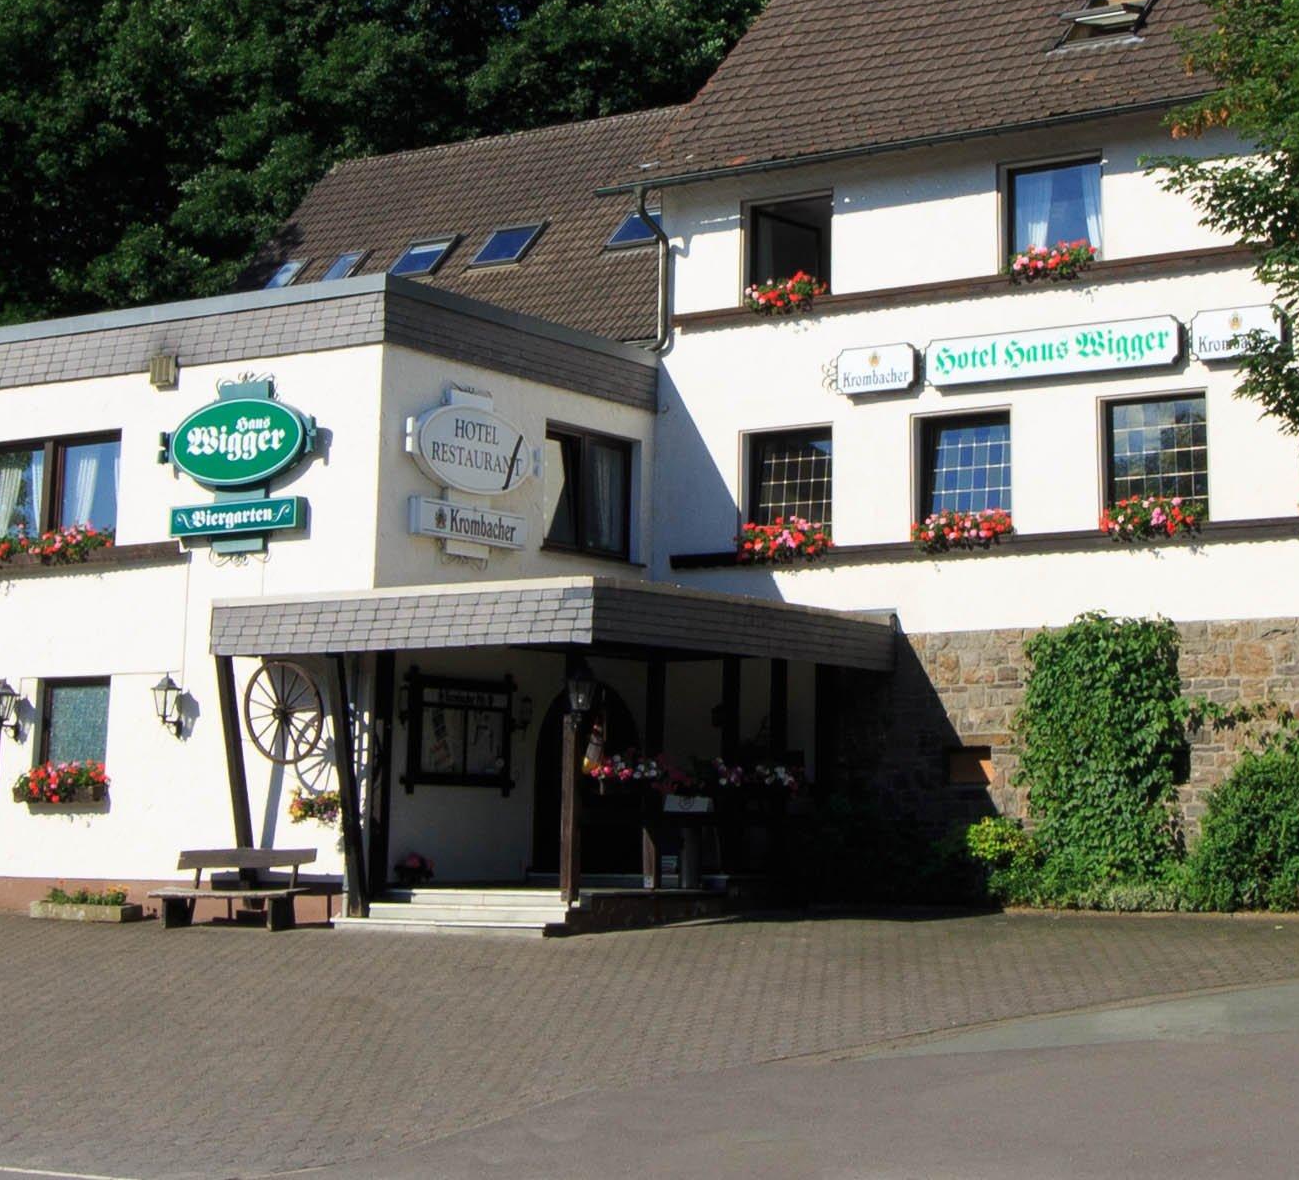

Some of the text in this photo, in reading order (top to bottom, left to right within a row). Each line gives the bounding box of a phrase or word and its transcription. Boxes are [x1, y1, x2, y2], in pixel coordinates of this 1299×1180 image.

[935, 329, 1170, 375] Hotel Haus Wigger
[843, 367, 910, 388] Krombacher
[235, 416, 271, 432] Haus
[454, 418, 499, 445] HOTEL
[186, 424, 286, 461] Wigger
[431, 440, 523, 477] RESTAURANT
[191, 507, 273, 529] Biergarten
[450, 507, 517, 542] Krombacher
